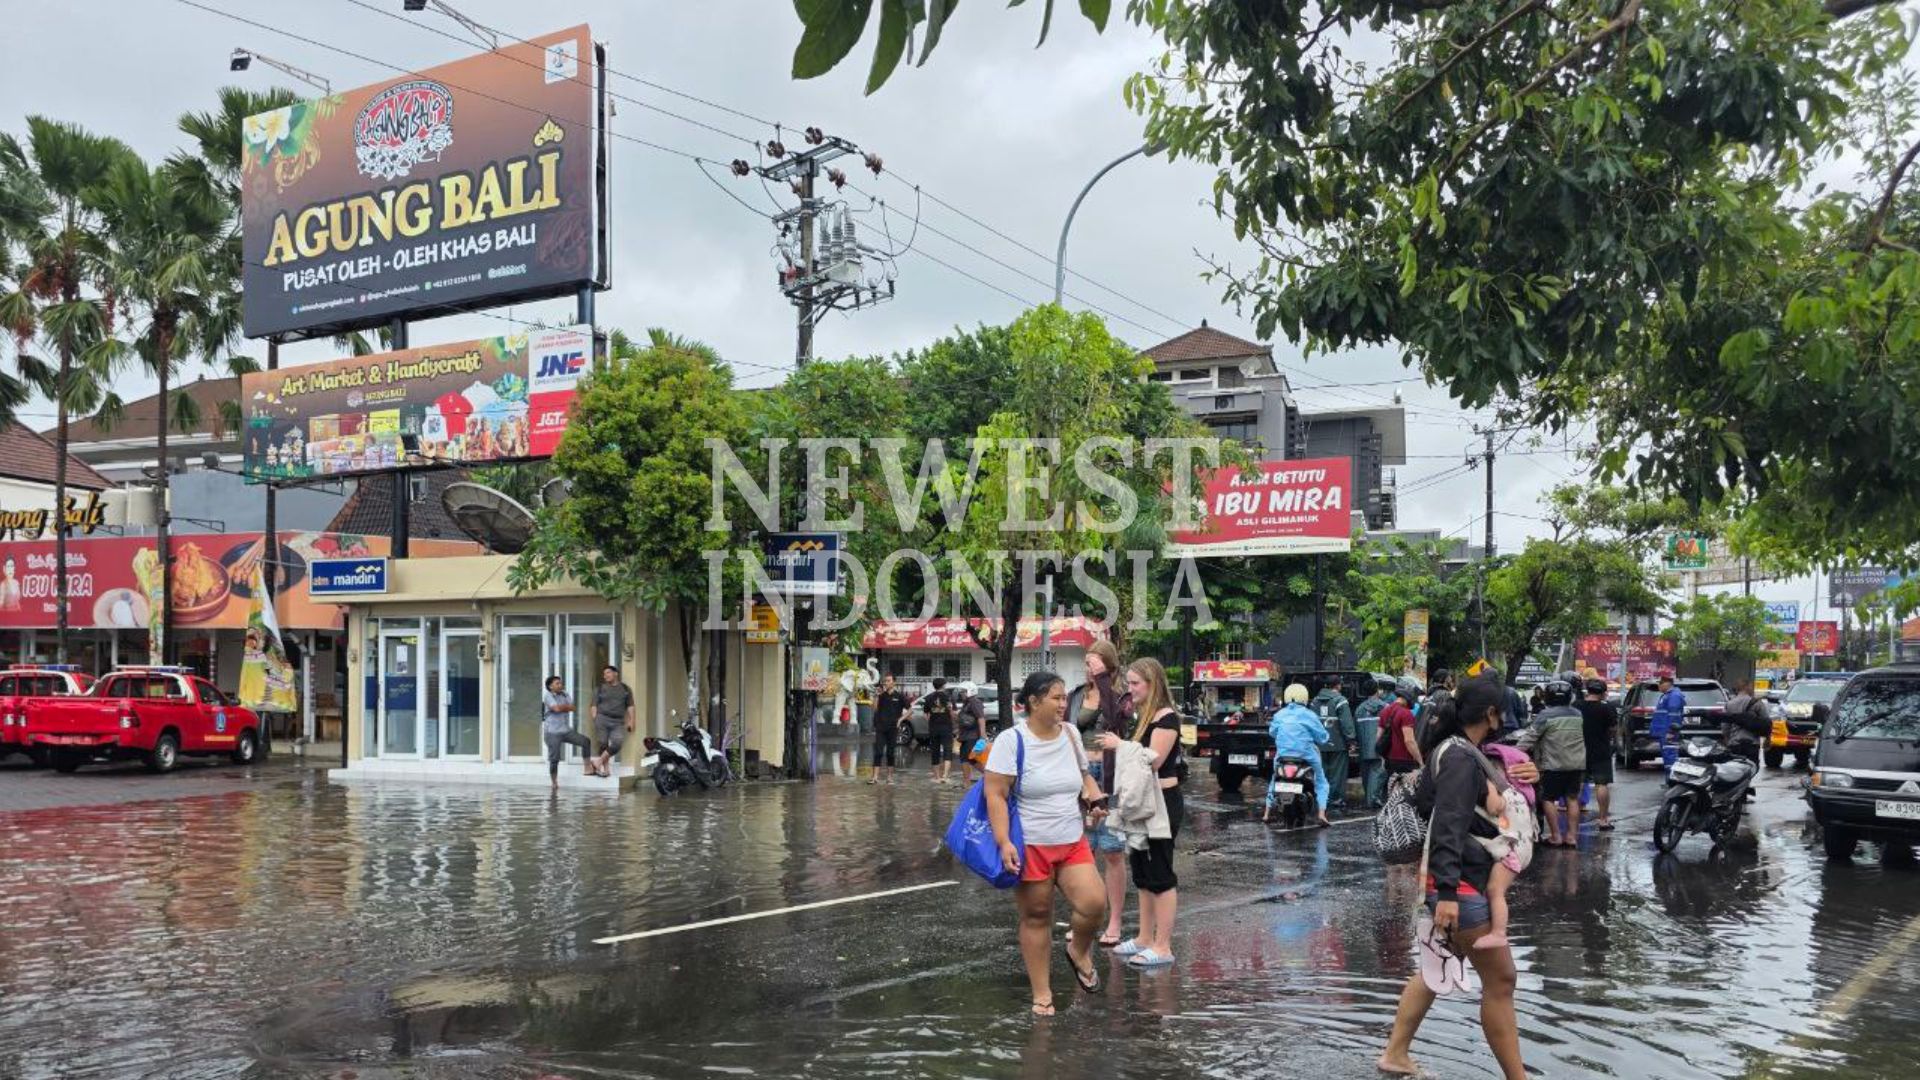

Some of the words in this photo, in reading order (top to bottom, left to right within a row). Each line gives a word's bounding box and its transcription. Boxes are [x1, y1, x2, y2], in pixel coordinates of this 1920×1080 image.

[263, 184, 432, 267] AGUNG
[440, 152, 560, 229] BALI
[283, 263, 337, 292] PUSAT
[338, 255, 381, 281] OLEH
[393, 243, 439, 271] OLEH
[441, 232, 492, 261] KHAS
[495, 223, 536, 251] BALI
[281, 376, 307, 397] Art
[309, 369, 365, 392] Market
[369, 365, 381, 384] &
[387, 351, 482, 384] Handycraft
[536, 351, 585, 378] JNE
[1273, 469, 1327, 484] BETUTU
[1214, 491, 1261, 516] IBU
[1268, 486, 1342, 513] MIRA
[1236, 516, 1259, 526] ASLI
[1261, 513, 1320, 526] GILIMANUK
[23, 574, 49, 597] IBU
[333, 571, 376, 586] mandiri
